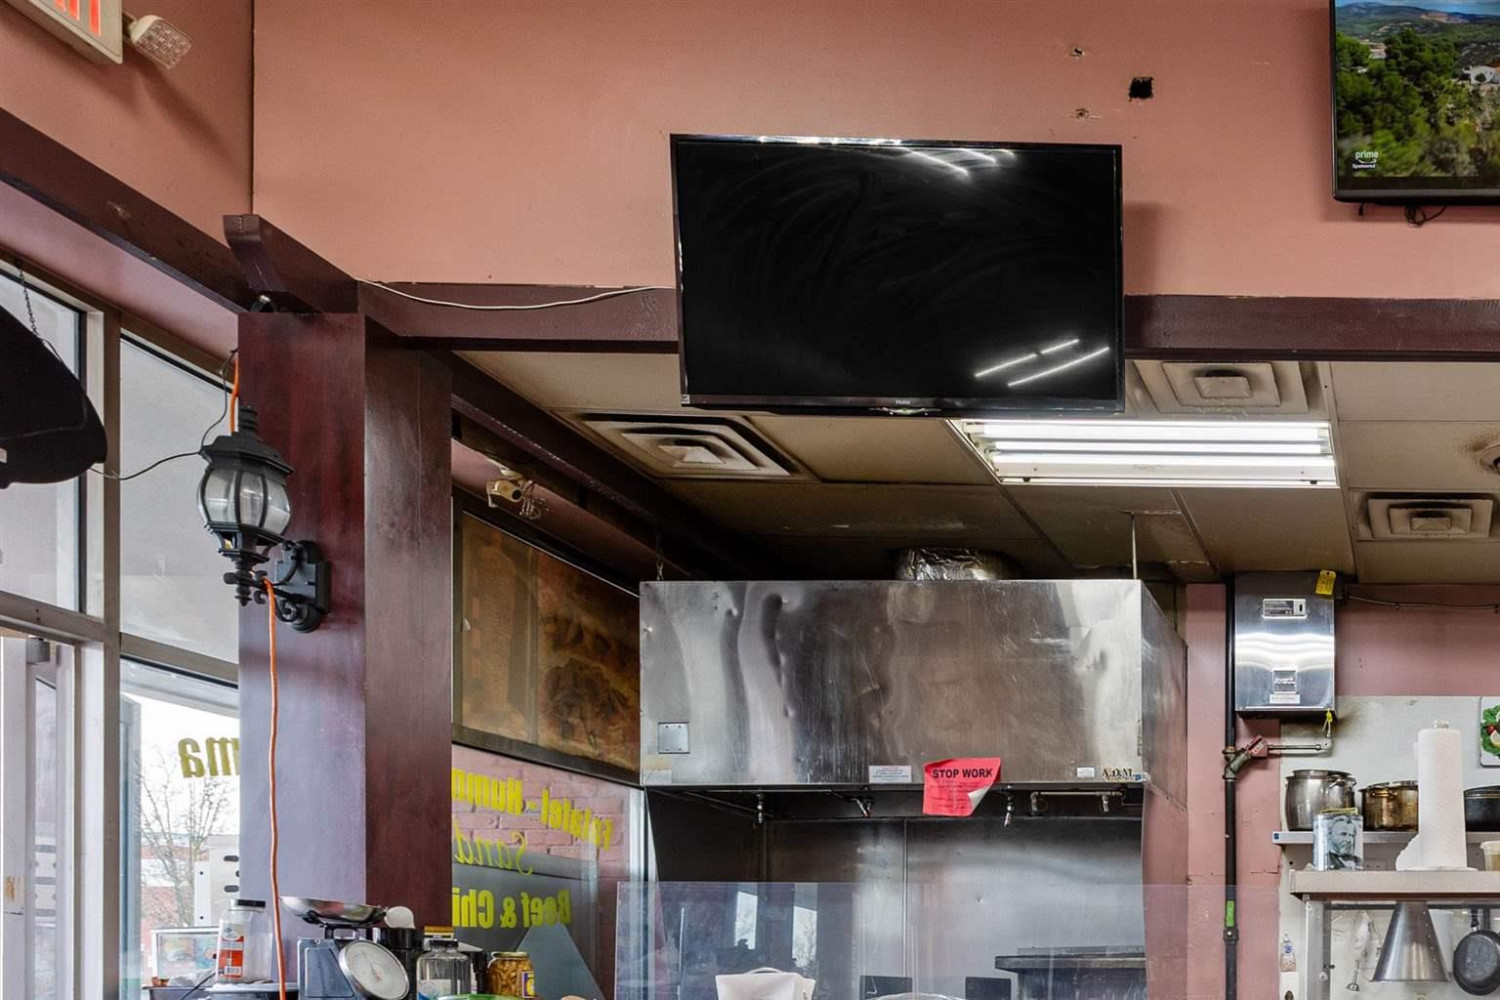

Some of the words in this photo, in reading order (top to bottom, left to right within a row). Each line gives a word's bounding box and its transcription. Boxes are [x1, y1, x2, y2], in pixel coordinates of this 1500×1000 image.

[1355, 151, 1379, 160] prime
[932, 769, 960, 779] STOP
[962, 768, 993, 778] WORK
